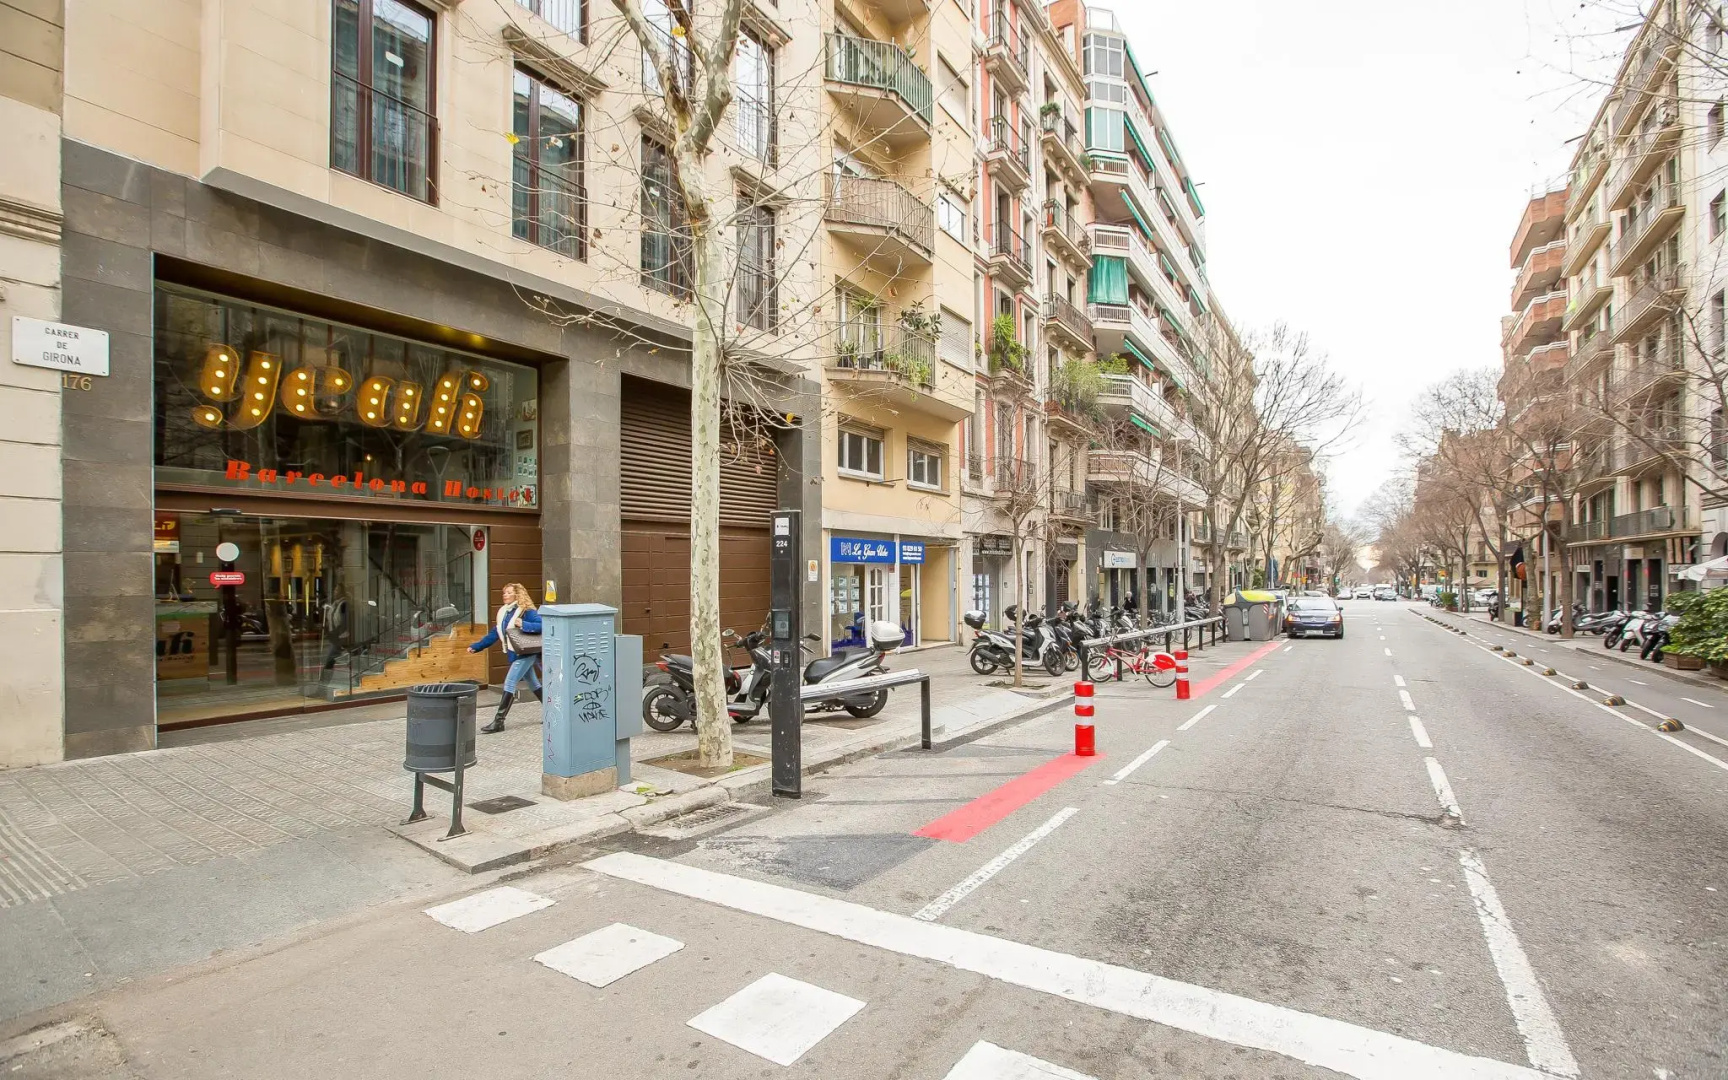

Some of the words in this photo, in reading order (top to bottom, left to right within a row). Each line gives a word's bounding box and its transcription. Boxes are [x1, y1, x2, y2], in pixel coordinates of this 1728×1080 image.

[45, 327, 79, 339] CARRER
[56, 341, 68, 350] DE
[42, 351, 81, 366] GIRONA
[61, 373, 92, 391] 176
[225, 459, 428, 495] Barcelona
[444, 480, 533, 503] Hostel
